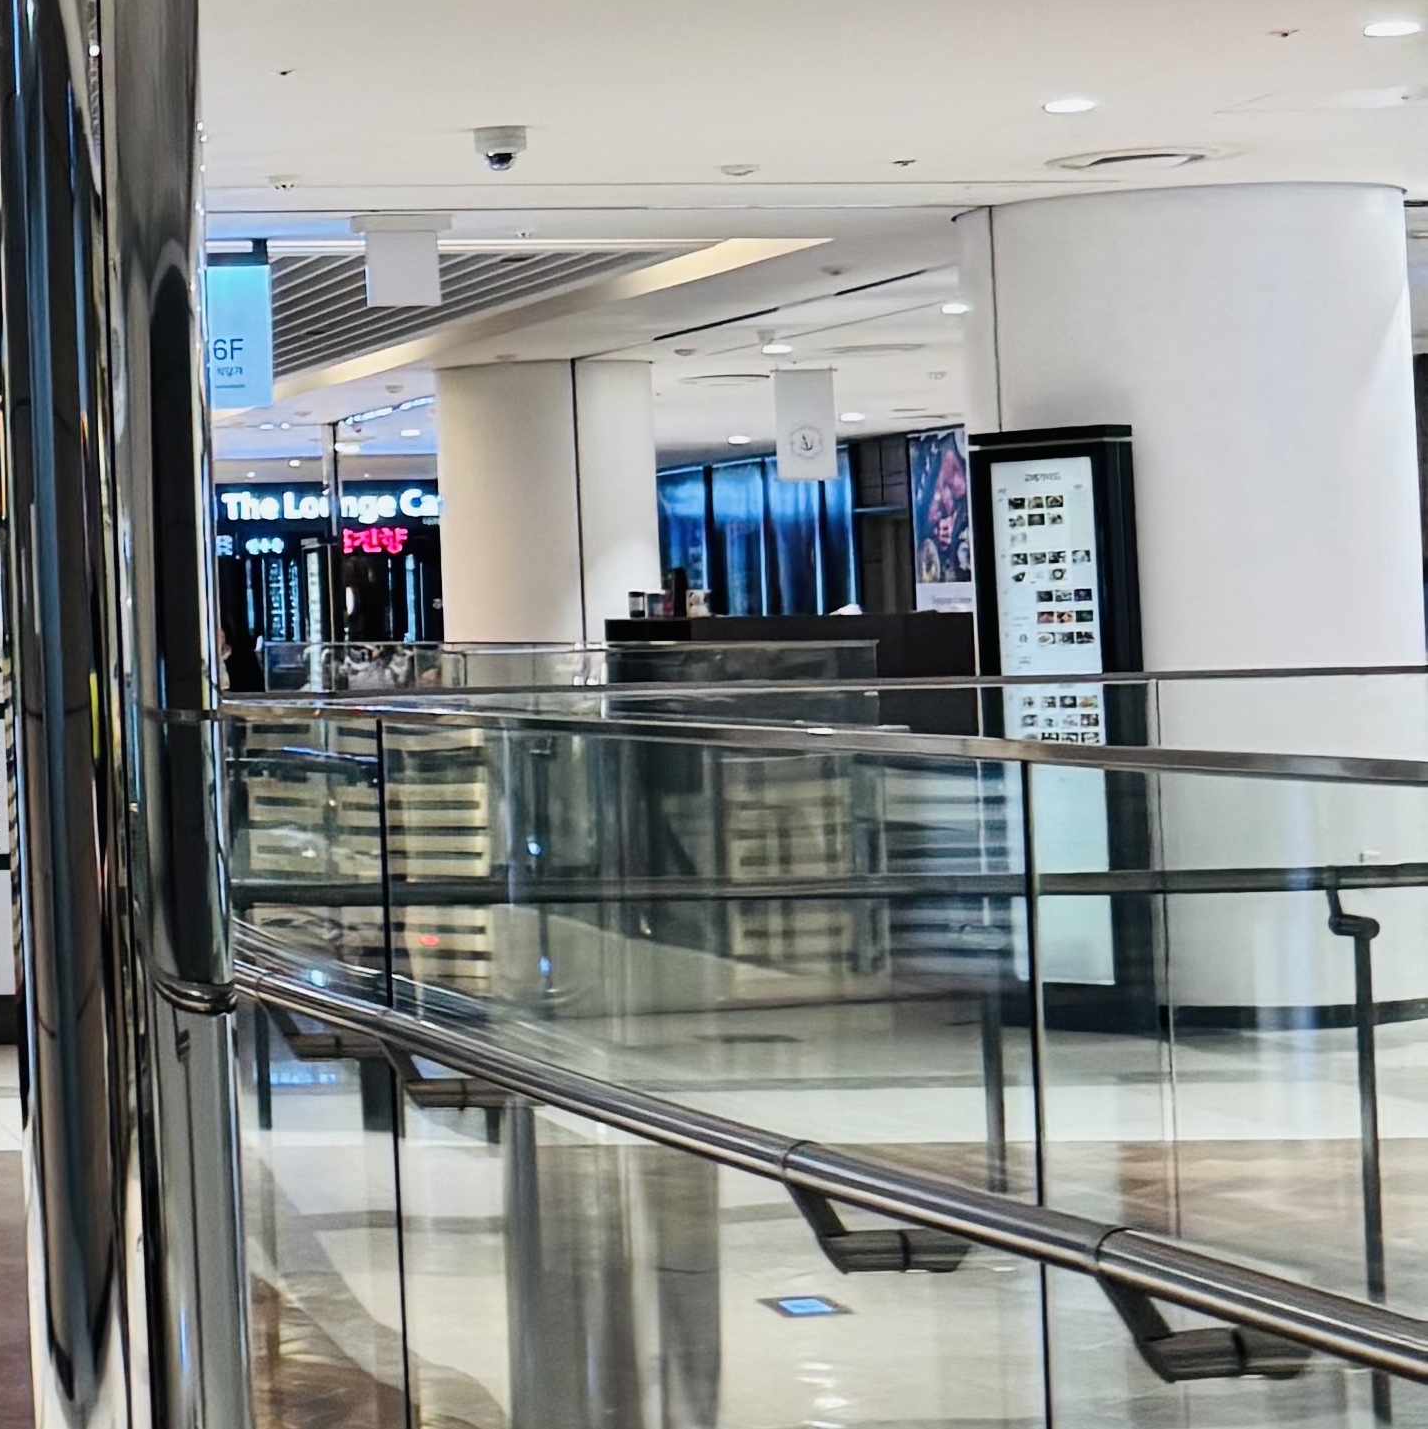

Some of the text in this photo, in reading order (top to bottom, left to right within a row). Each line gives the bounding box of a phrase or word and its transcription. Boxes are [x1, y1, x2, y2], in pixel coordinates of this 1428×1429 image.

[213, 338, 244, 360] 6F
[221, 491, 280, 520] The
[400, 488, 443, 517] Ca
